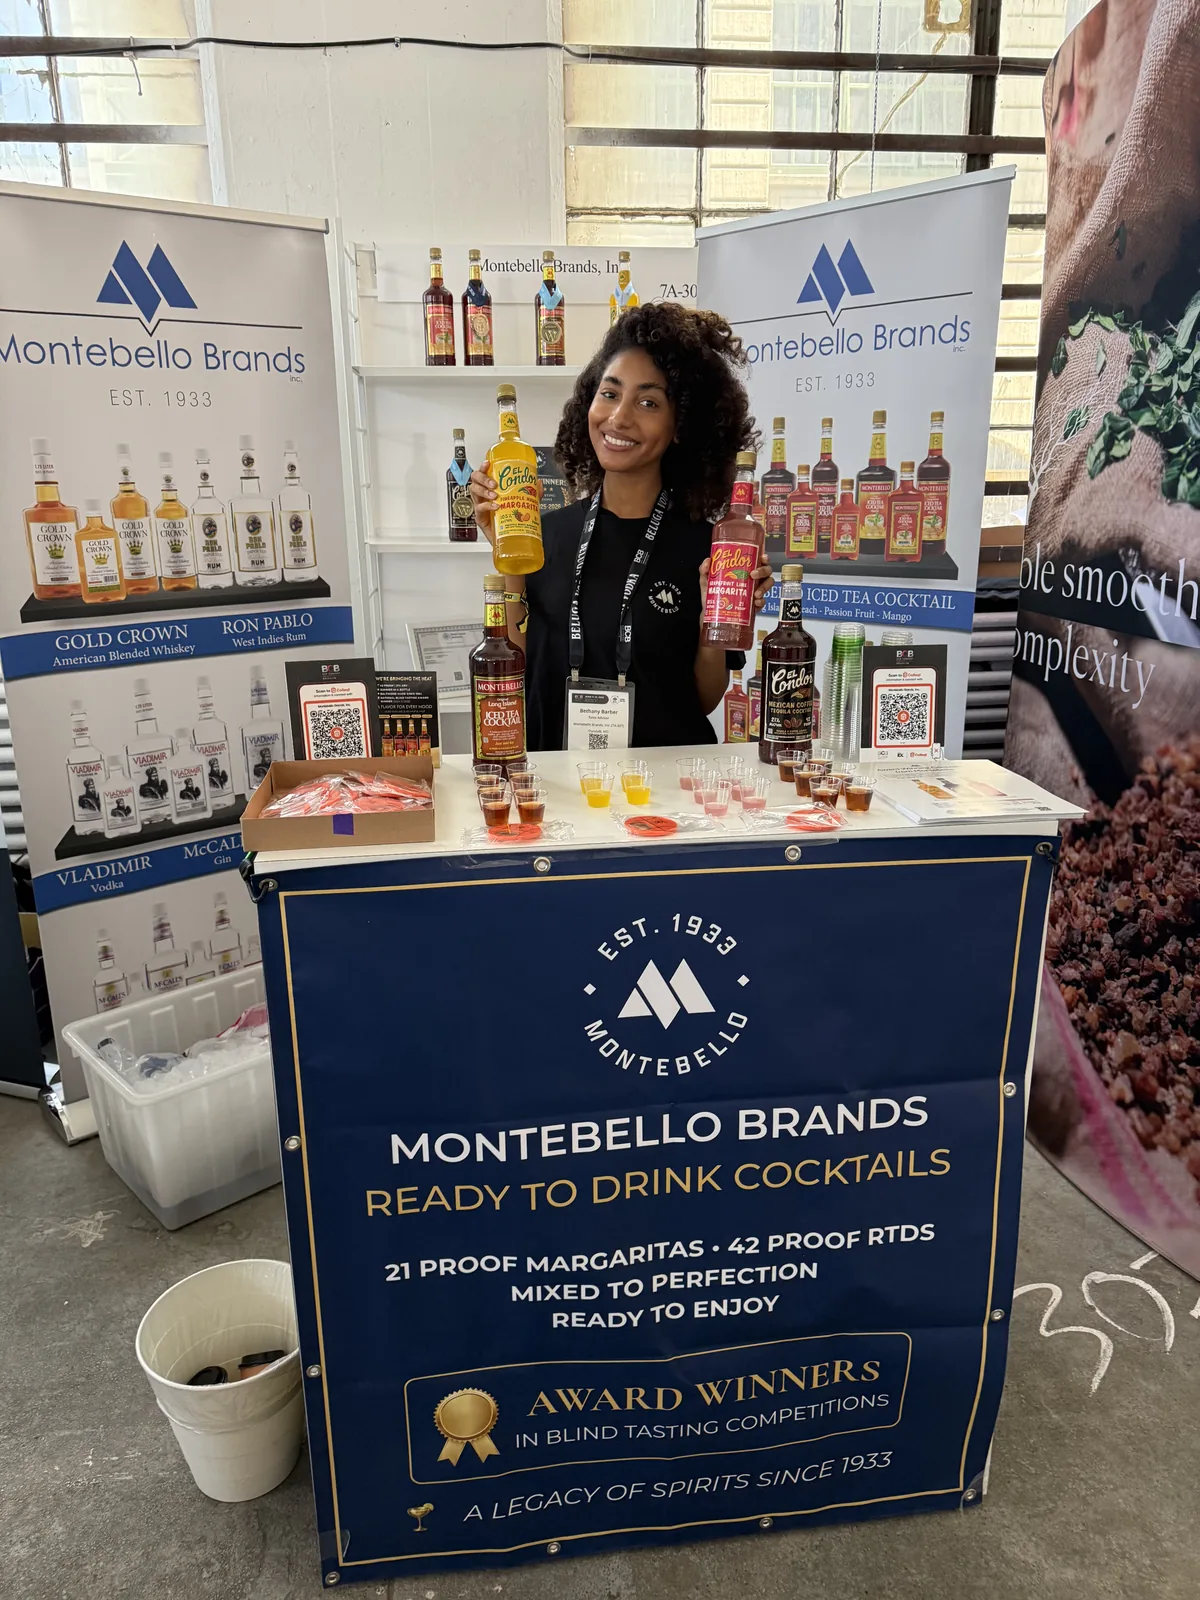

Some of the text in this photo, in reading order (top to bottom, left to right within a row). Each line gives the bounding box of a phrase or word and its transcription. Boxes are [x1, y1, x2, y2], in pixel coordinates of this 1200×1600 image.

[554, 260, 602, 276] Brands,
[606, 260, 619, 274] In
[746, 314, 970, 364] ontebello Brands
[0, 334, 306, 374] Montebello Brands
[796, 372, 876, 393] EST. 1933
[110, 389, 212, 408] EST. 1933
[512, 466, 522, 474] EL
[500, 502, 539, 513] MARGARITA
[40, 525, 67, 533] GOLD
[122, 522, 144, 530] GOLD
[160, 529, 188, 538] CROWN
[163, 521, 184, 529] GOLD
[644, 508, 664, 540] BELUGA
[37, 534, 72, 542] CROWN
[119, 530, 148, 538] CROWN
[634, 549, 644, 564] BCB
[710, 548, 752, 575] EL Condor
[708, 587, 747, 597] MARGARITA
[1062, 558, 1199, 620] smooth
[807, 588, 839, 602] ICED
[842, 590, 871, 605] TEA
[875, 592, 956, 610] COCKTAIL
[768, 602, 780, 612] Isla
[802, 605, 817, 614] each
[824, 607, 853, 617] Passion
[855, 608, 875, 618] Fruit
[883, 612, 912, 622] Mango
[221, 613, 313, 635] RON PABLO
[55, 624, 189, 651] GOLD CROWN
[232, 632, 306, 648] West Indies Rum
[52, 643, 195, 667] American Blended Whiskey
[772, 668, 813, 695] Condor
[787, 670, 798, 679] EL
[478, 680, 523, 691] MONTEBELLO
[484, 717, 521, 727] COCKTAIL
[485, 710, 519, 719] ICED TEA
[196, 743, 227, 754] VLADIMIR
[249, 734, 280, 744] VLADIMIR
[132, 752, 167, 765] VLADIMIR
[70, 763, 102, 774] VLADIMIR
[172, 766, 202, 777] VLADIMIR
[104, 786, 133, 798] VLADIMIR
[184, 836, 243, 860] McCAL
[214, 855, 232, 866] Gin
[56, 855, 152, 886] VLADIMIR
[90, 881, 124, 893] Vodka
[597, 913, 737, 961] EST. 1933
[584, 1012, 748, 1076] MONTEBELLO
[390, 1096, 929, 1164] MONTEBELLO BRANDS
[366, 1148, 951, 1217] READY TO DRINK COCKTAILS
[385, 1224, 936, 1282] 21 PROOF MARGARITAS 42 PROOF RTDS
[511, 1262, 818, 1303] MIXED TO PERFECTION
[552, 1295, 780, 1328] READY TO ENJOY
[526, 1358, 882, 1417] AWARD WINNERS
[516, 1394, 890, 1448] IN BLIND TASTING COMPETITIONS
[464, 1450, 894, 1522] A LEGACY OF SPIRITS SINCE 1933
